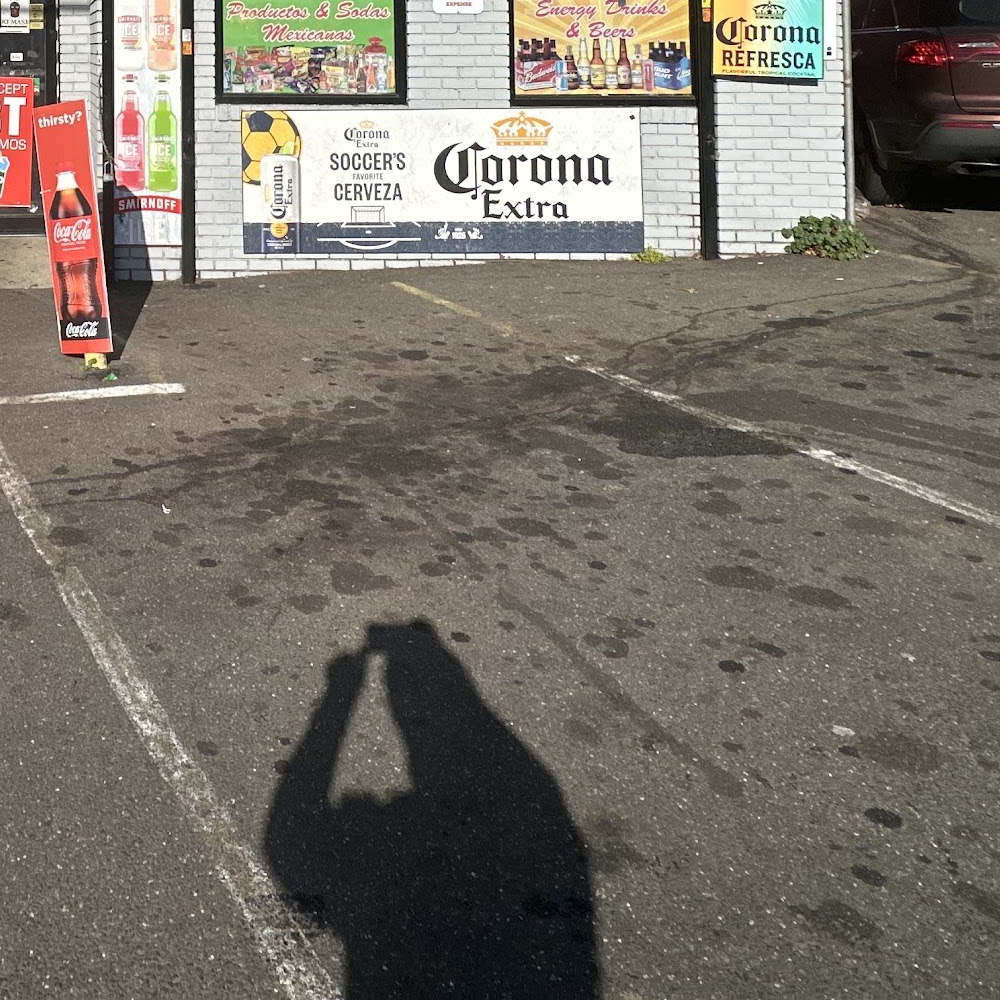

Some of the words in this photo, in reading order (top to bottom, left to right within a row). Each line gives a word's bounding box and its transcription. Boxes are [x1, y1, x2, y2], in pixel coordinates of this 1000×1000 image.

[226, 1, 309, 20] Productos
[315, 1, 330, 18] &
[335, 1, 391, 19] Sodas
[261, 23, 355, 42] Mexicanas
[566, 21, 581, 38] &
[588, 21, 637, 38] Beers
[715, 16, 821, 49] Corona
[722, 49, 816, 70] REFRESCA
[38, 110, 83, 129] thirsty?
[344, 127, 390, 143] Corona
[356, 140, 379, 148] Extra
[329, 152, 406, 171] SOCCER'S
[433, 141, 613, 200] Corona
[270, 164, 287, 219] Corona
[285, 178, 293, 205] Extra
[334, 183, 403, 201] CERVEZA
[118, 198, 177, 211] SMIRNOFF
[481, 188, 570, 219] Extra
